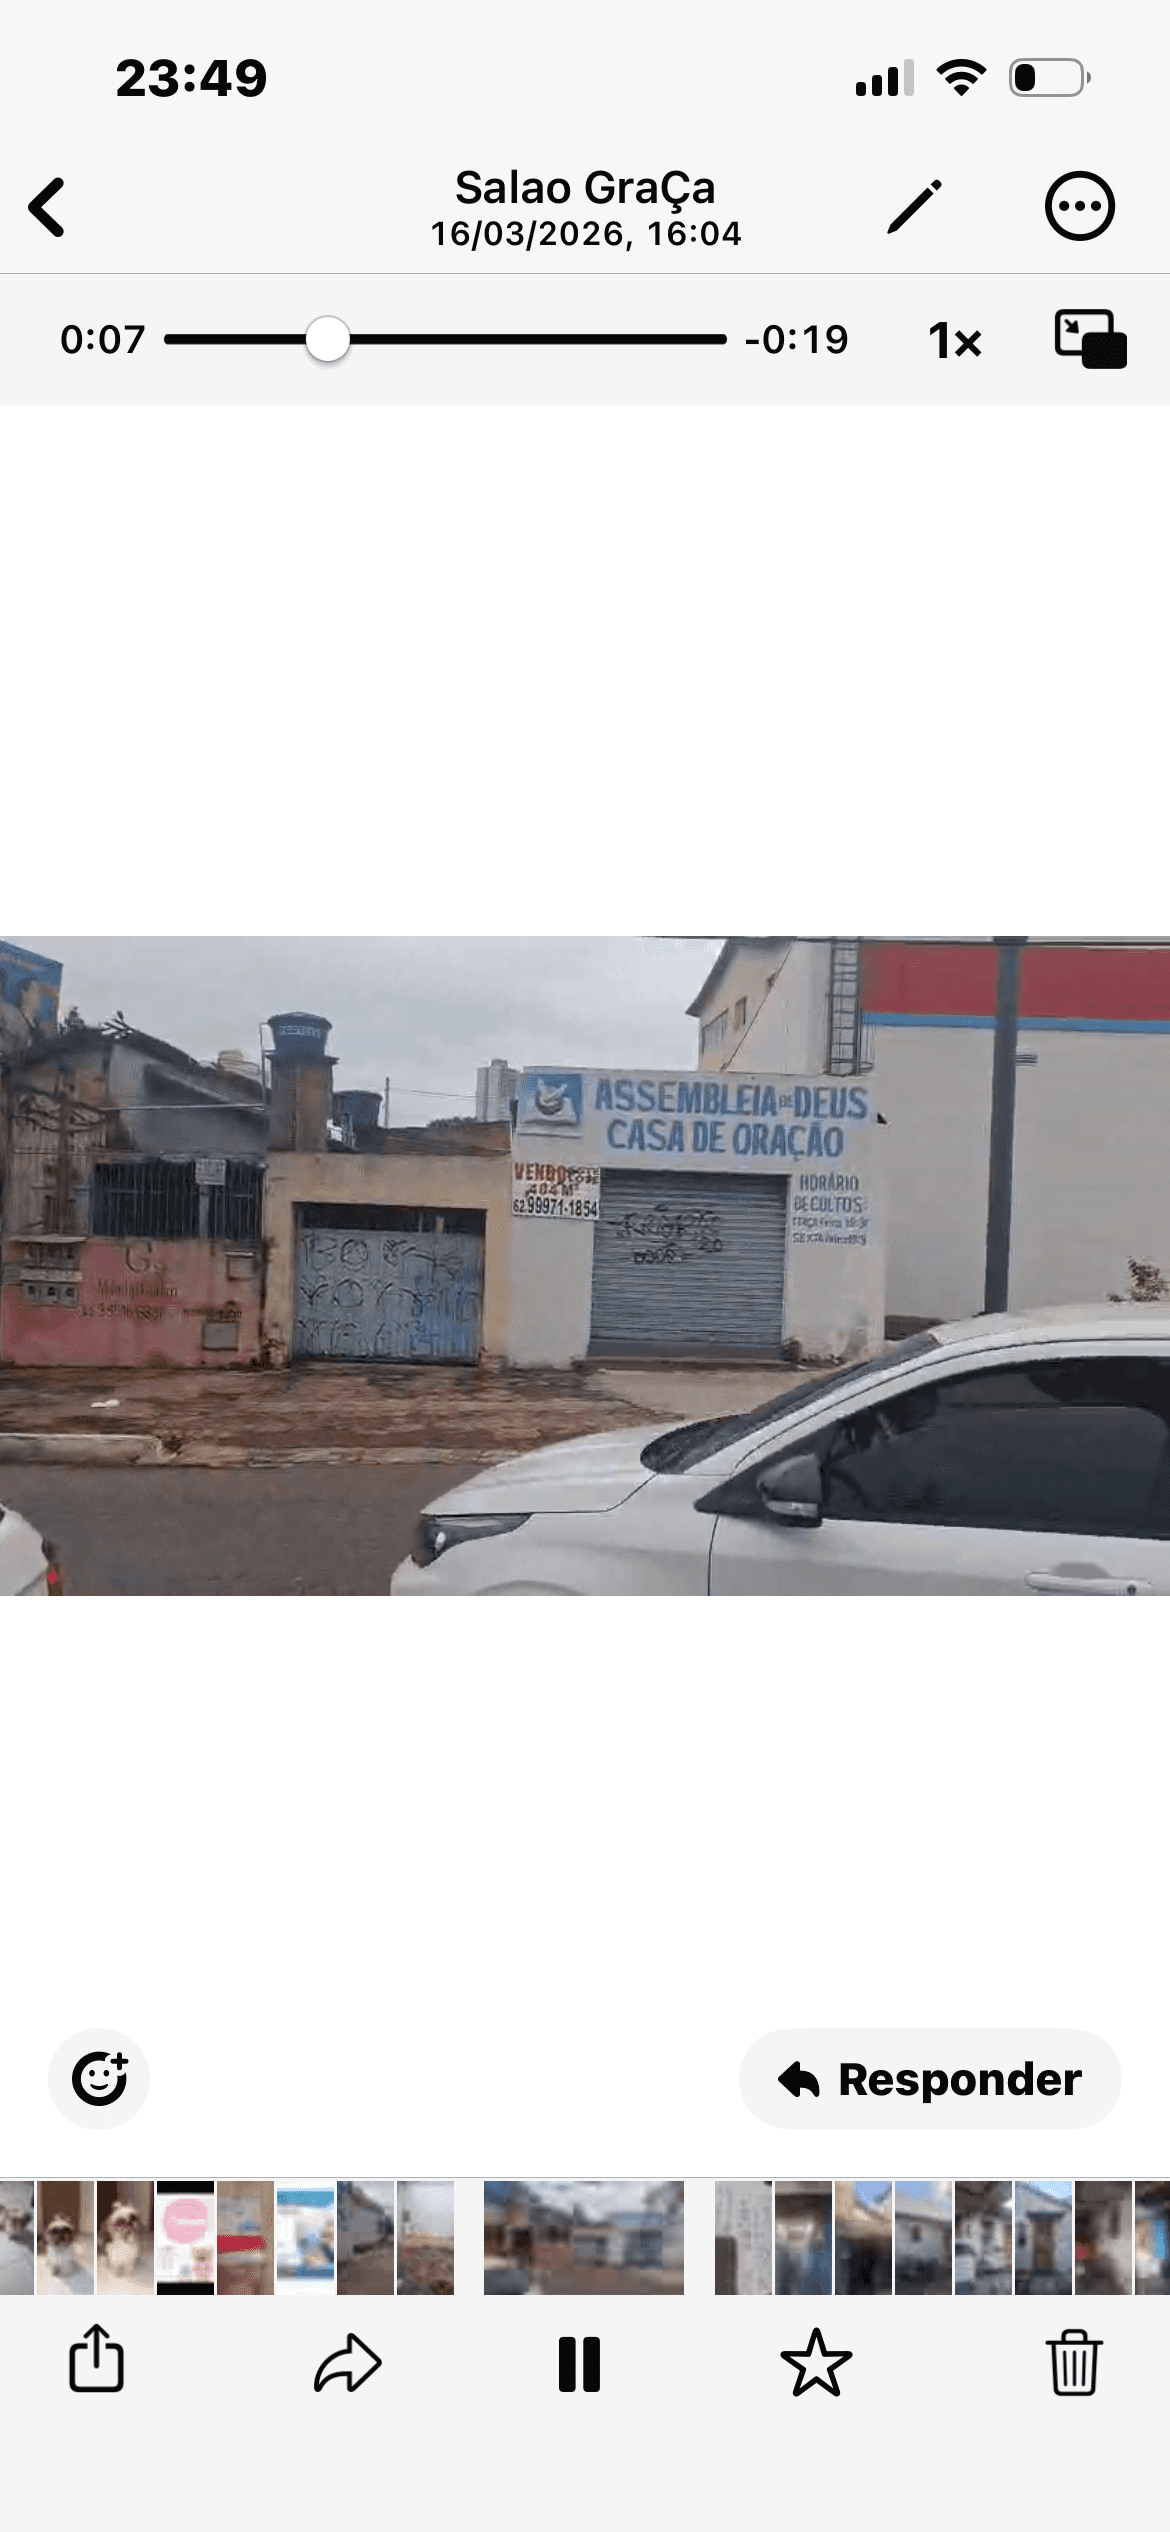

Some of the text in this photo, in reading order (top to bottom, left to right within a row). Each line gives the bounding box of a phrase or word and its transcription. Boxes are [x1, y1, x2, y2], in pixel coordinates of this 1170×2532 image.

[595, 1078, 778, 1117] ASSEMBLEIA
[794, 1086, 868, 1119] DEUS
[607, 1118, 844, 1162] CASA DE ORAÇÃO
[514, 1162, 567, 1182] VENDO
[799, 1171, 859, 1191] HORÁRIO
